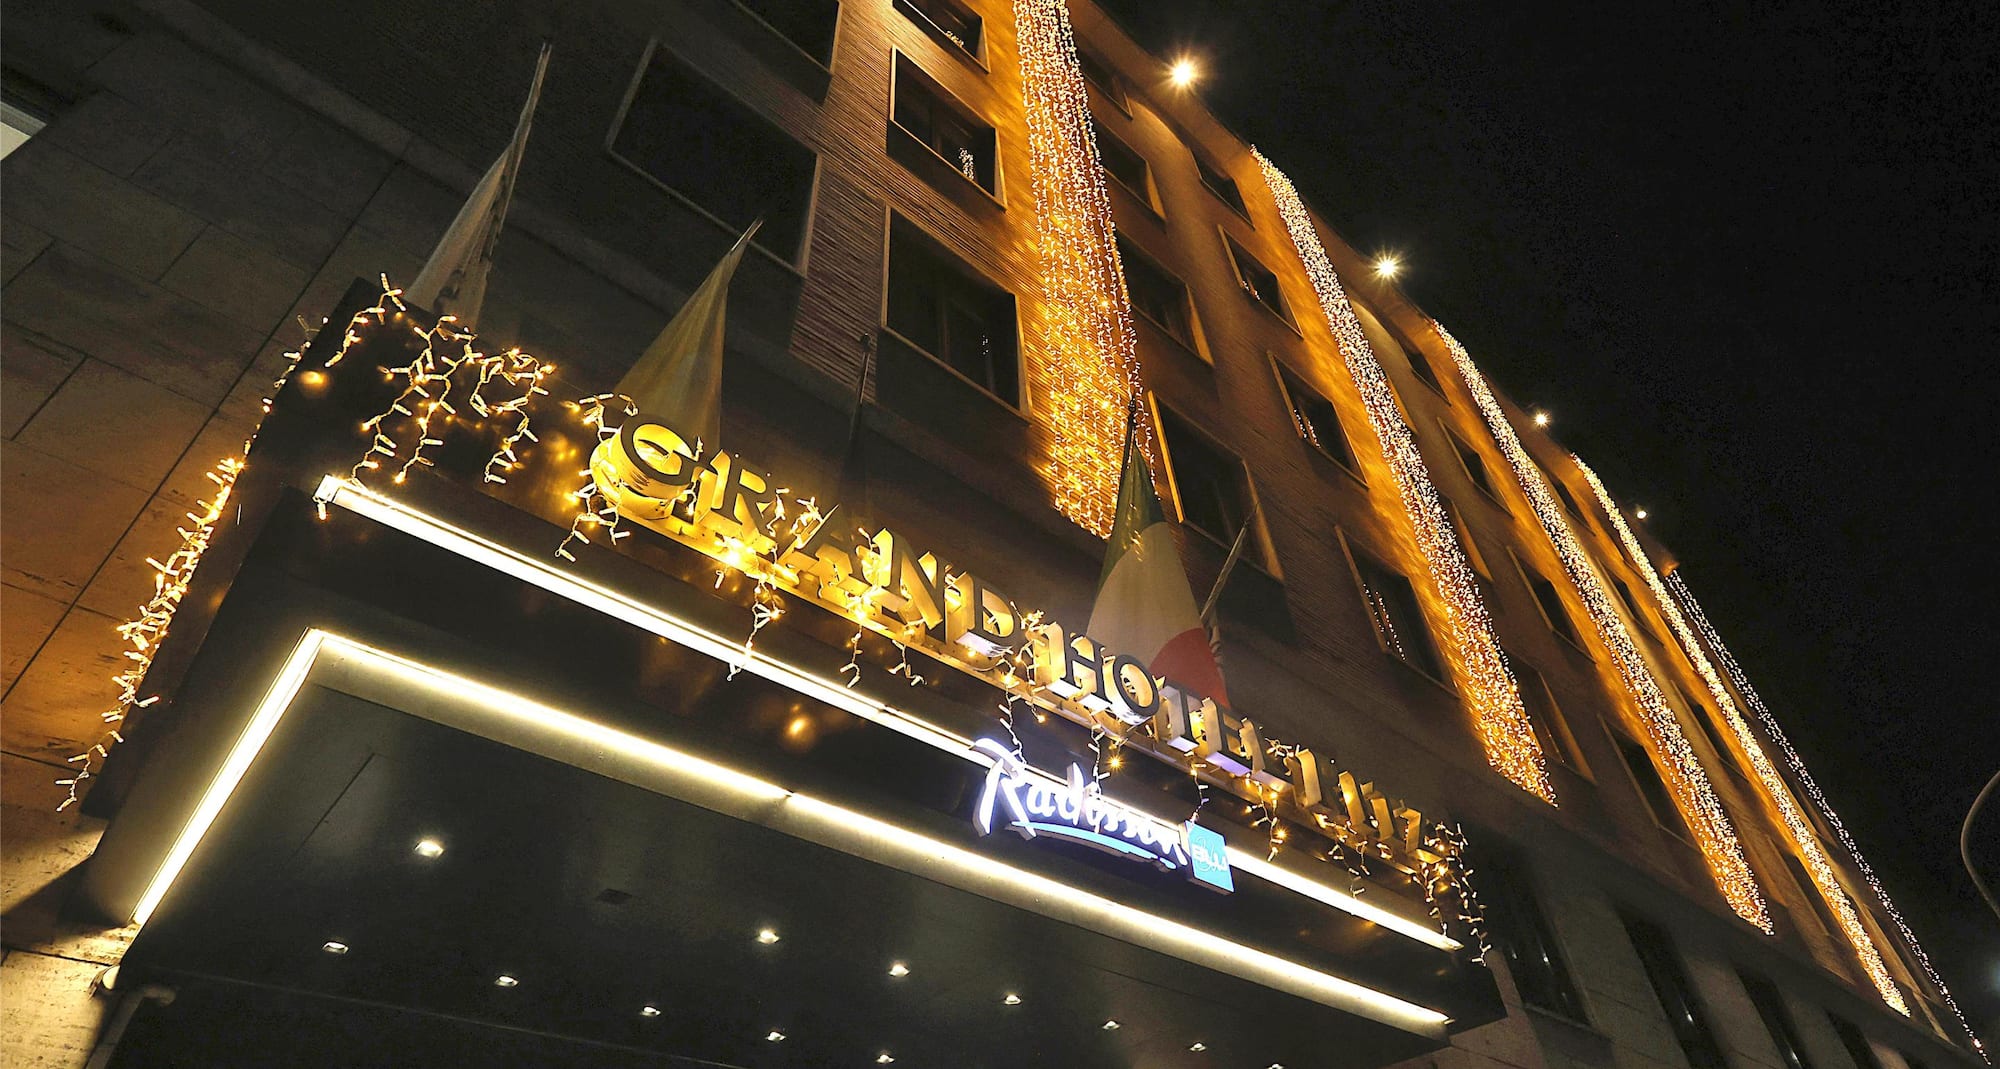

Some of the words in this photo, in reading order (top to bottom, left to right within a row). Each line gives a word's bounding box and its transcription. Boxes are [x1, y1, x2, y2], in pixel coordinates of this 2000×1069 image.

[592, 414, 1025, 660] GRAND
[1032, 621, 1294, 790] HOTEL
[976, 737, 1189, 867] Radisson
